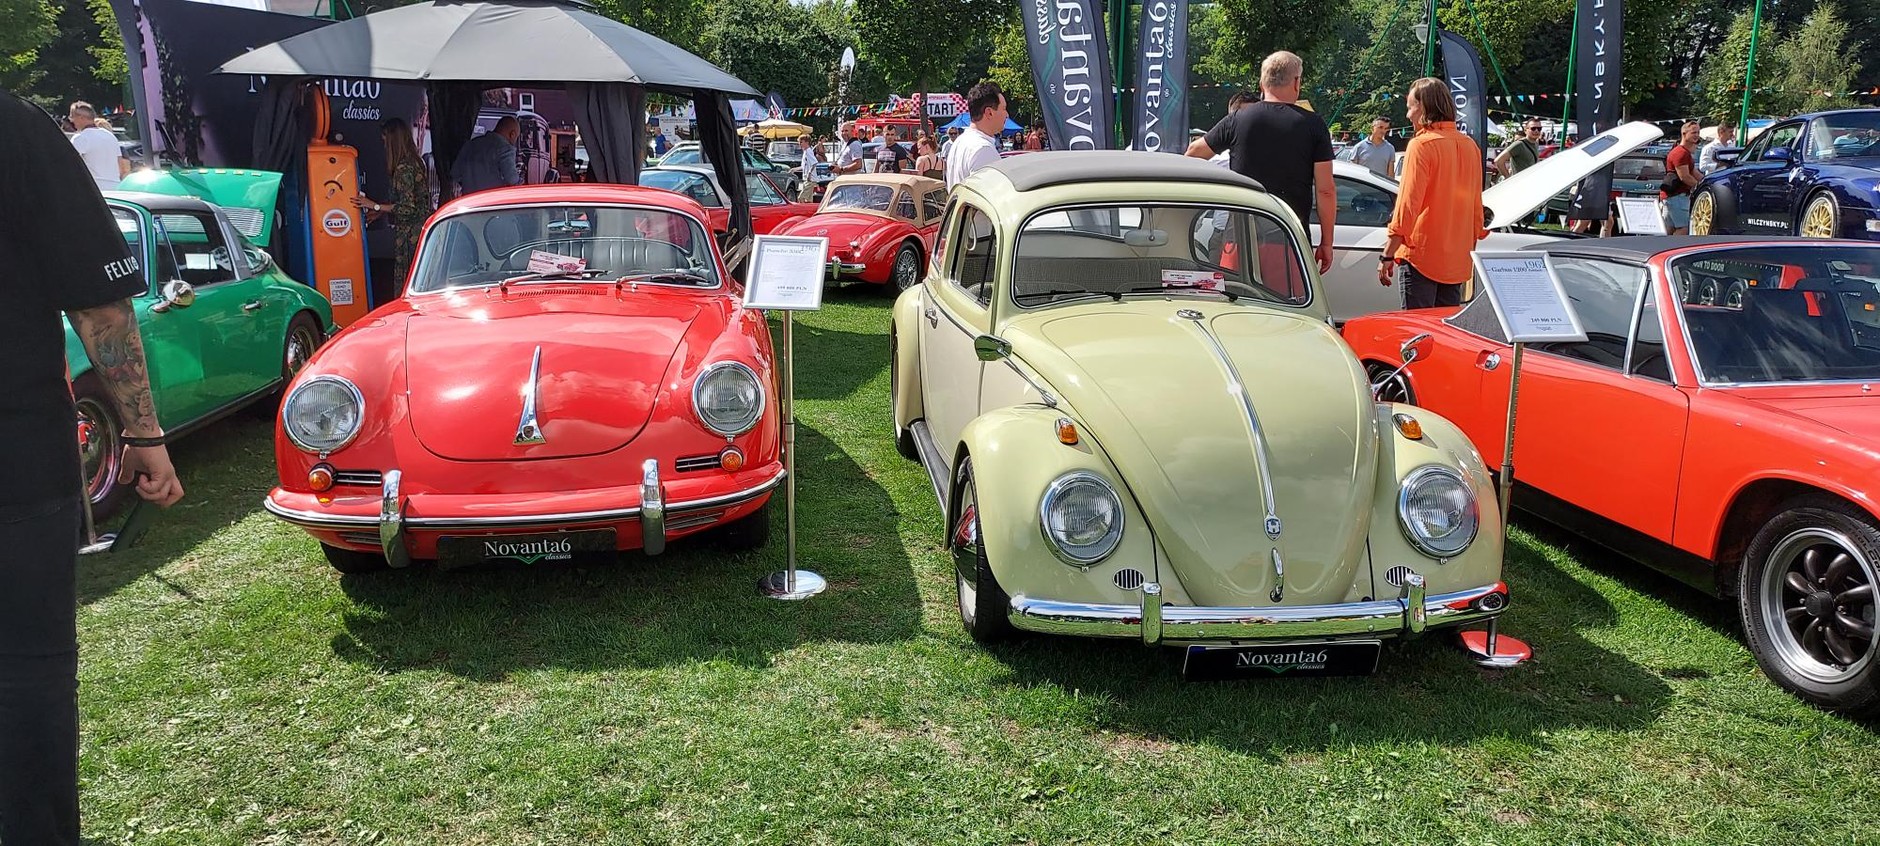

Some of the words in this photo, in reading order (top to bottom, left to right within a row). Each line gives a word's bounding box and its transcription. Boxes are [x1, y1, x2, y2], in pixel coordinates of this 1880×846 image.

[1164, 2, 1176, 58] classics
[342, 100, 381, 120] classics
[484, 538, 571, 556] Novanta6
[545, 552, 571, 560] classics
[1236, 650, 1327, 666] Novanta6
[1296, 662, 1325, 670] classics
